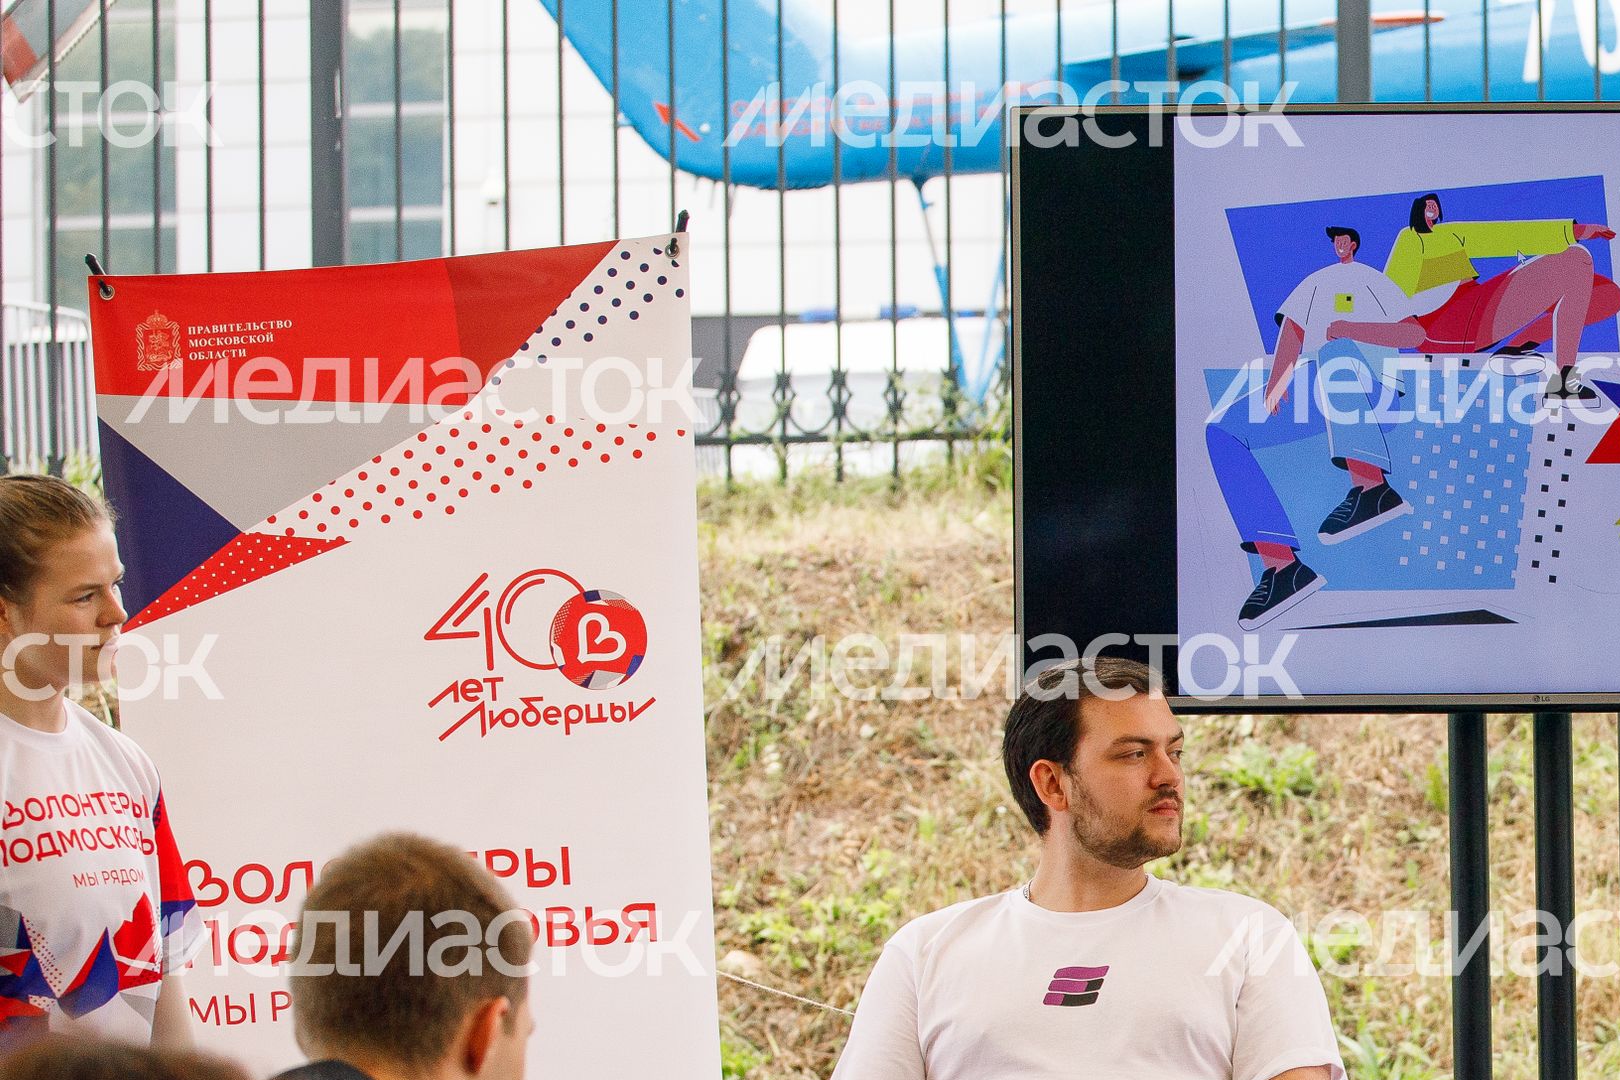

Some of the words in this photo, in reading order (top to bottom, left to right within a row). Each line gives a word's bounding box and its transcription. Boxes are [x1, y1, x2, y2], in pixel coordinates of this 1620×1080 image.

[187, 319, 293, 335] ПРАВИТЕЛЬСТВО
[188, 332, 274, 348] МОСКОВСКОЙ
[188, 348, 247, 361] ОБЛАСТИ
[438, 696, 656, 742] Люберцы
[2, 791, 150, 831] ВОЛОНТЕРЫ
[73, 871, 98, 888] МЫ
[102, 868, 144, 886] РЯДОМ
[189, 993, 257, 1026] МЫ
